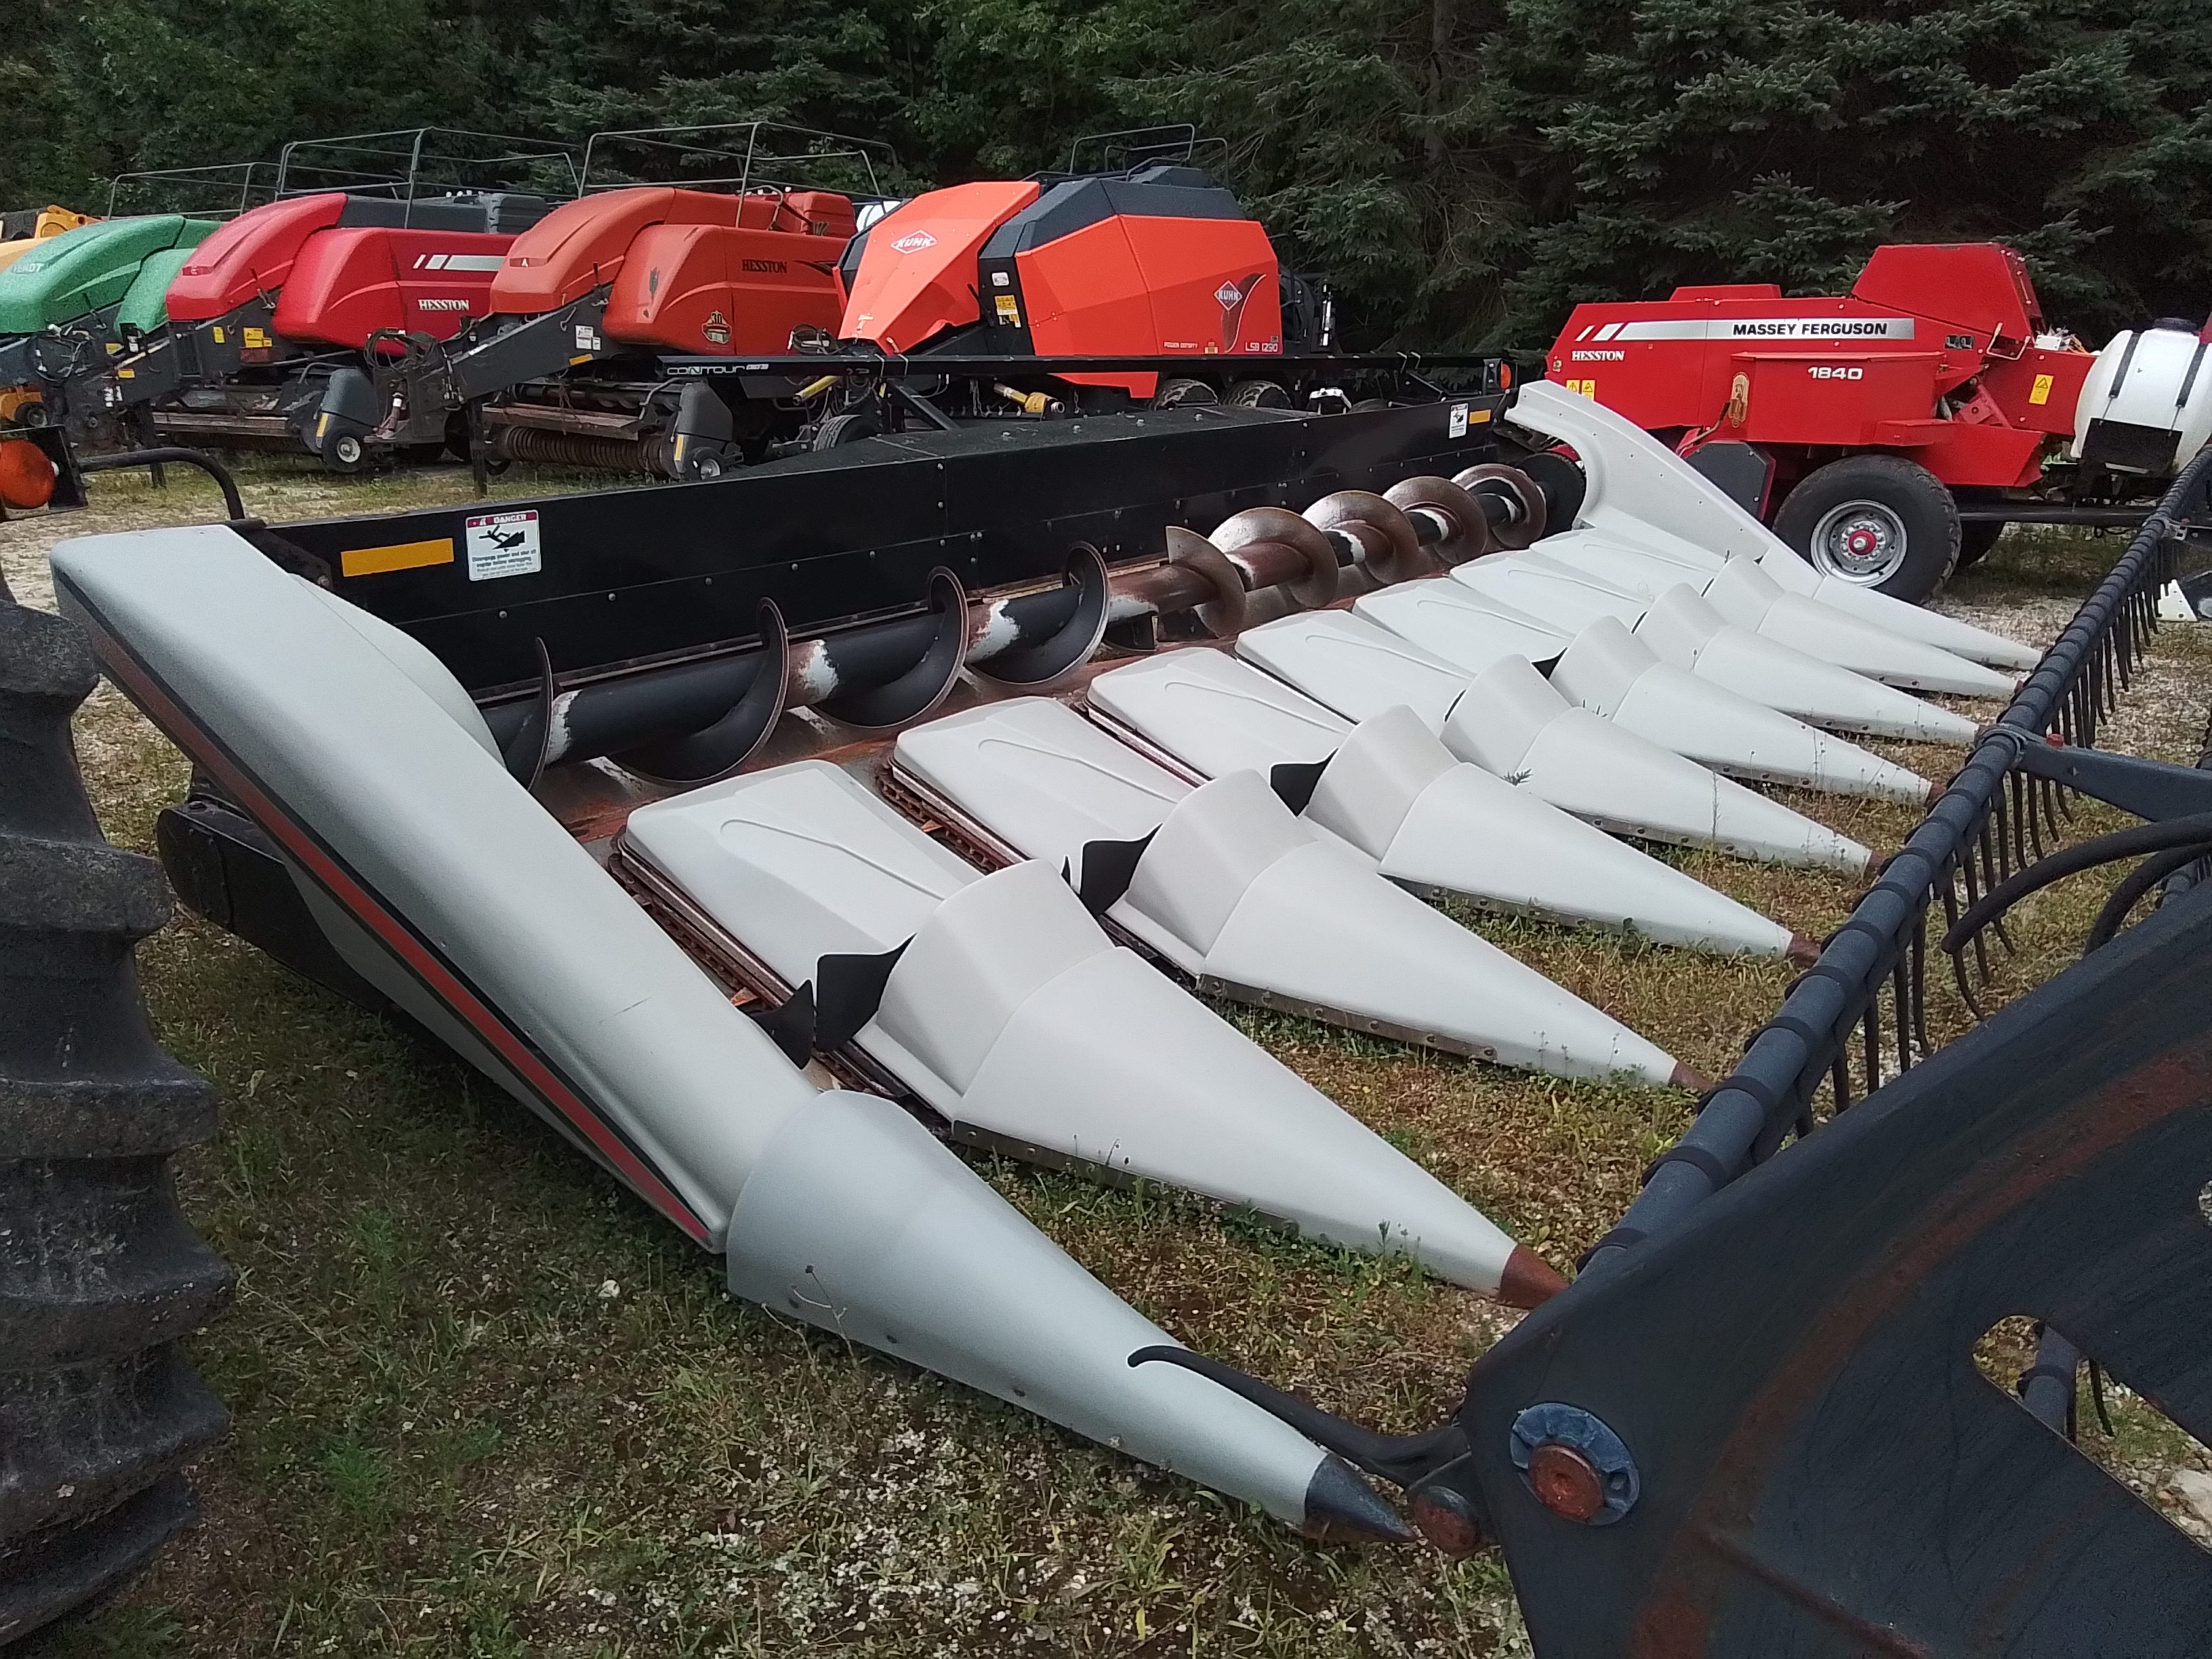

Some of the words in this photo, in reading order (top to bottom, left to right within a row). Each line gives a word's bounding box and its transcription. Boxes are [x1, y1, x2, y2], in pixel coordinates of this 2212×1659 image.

[895, 237, 930, 249] KUHN
[741, 259, 787, 273] HESSTON
[1218, 289, 1238, 300] KUHN
[417, 299, 470, 311] HESSTON
[1732, 323, 1797, 335] MASSEY
[1801, 322, 1888, 335] FERGUSON
[1572, 350, 1625, 361] HESSTON
[1807, 367, 1863, 380] 1840
[493, 514, 527, 524] DANGER
